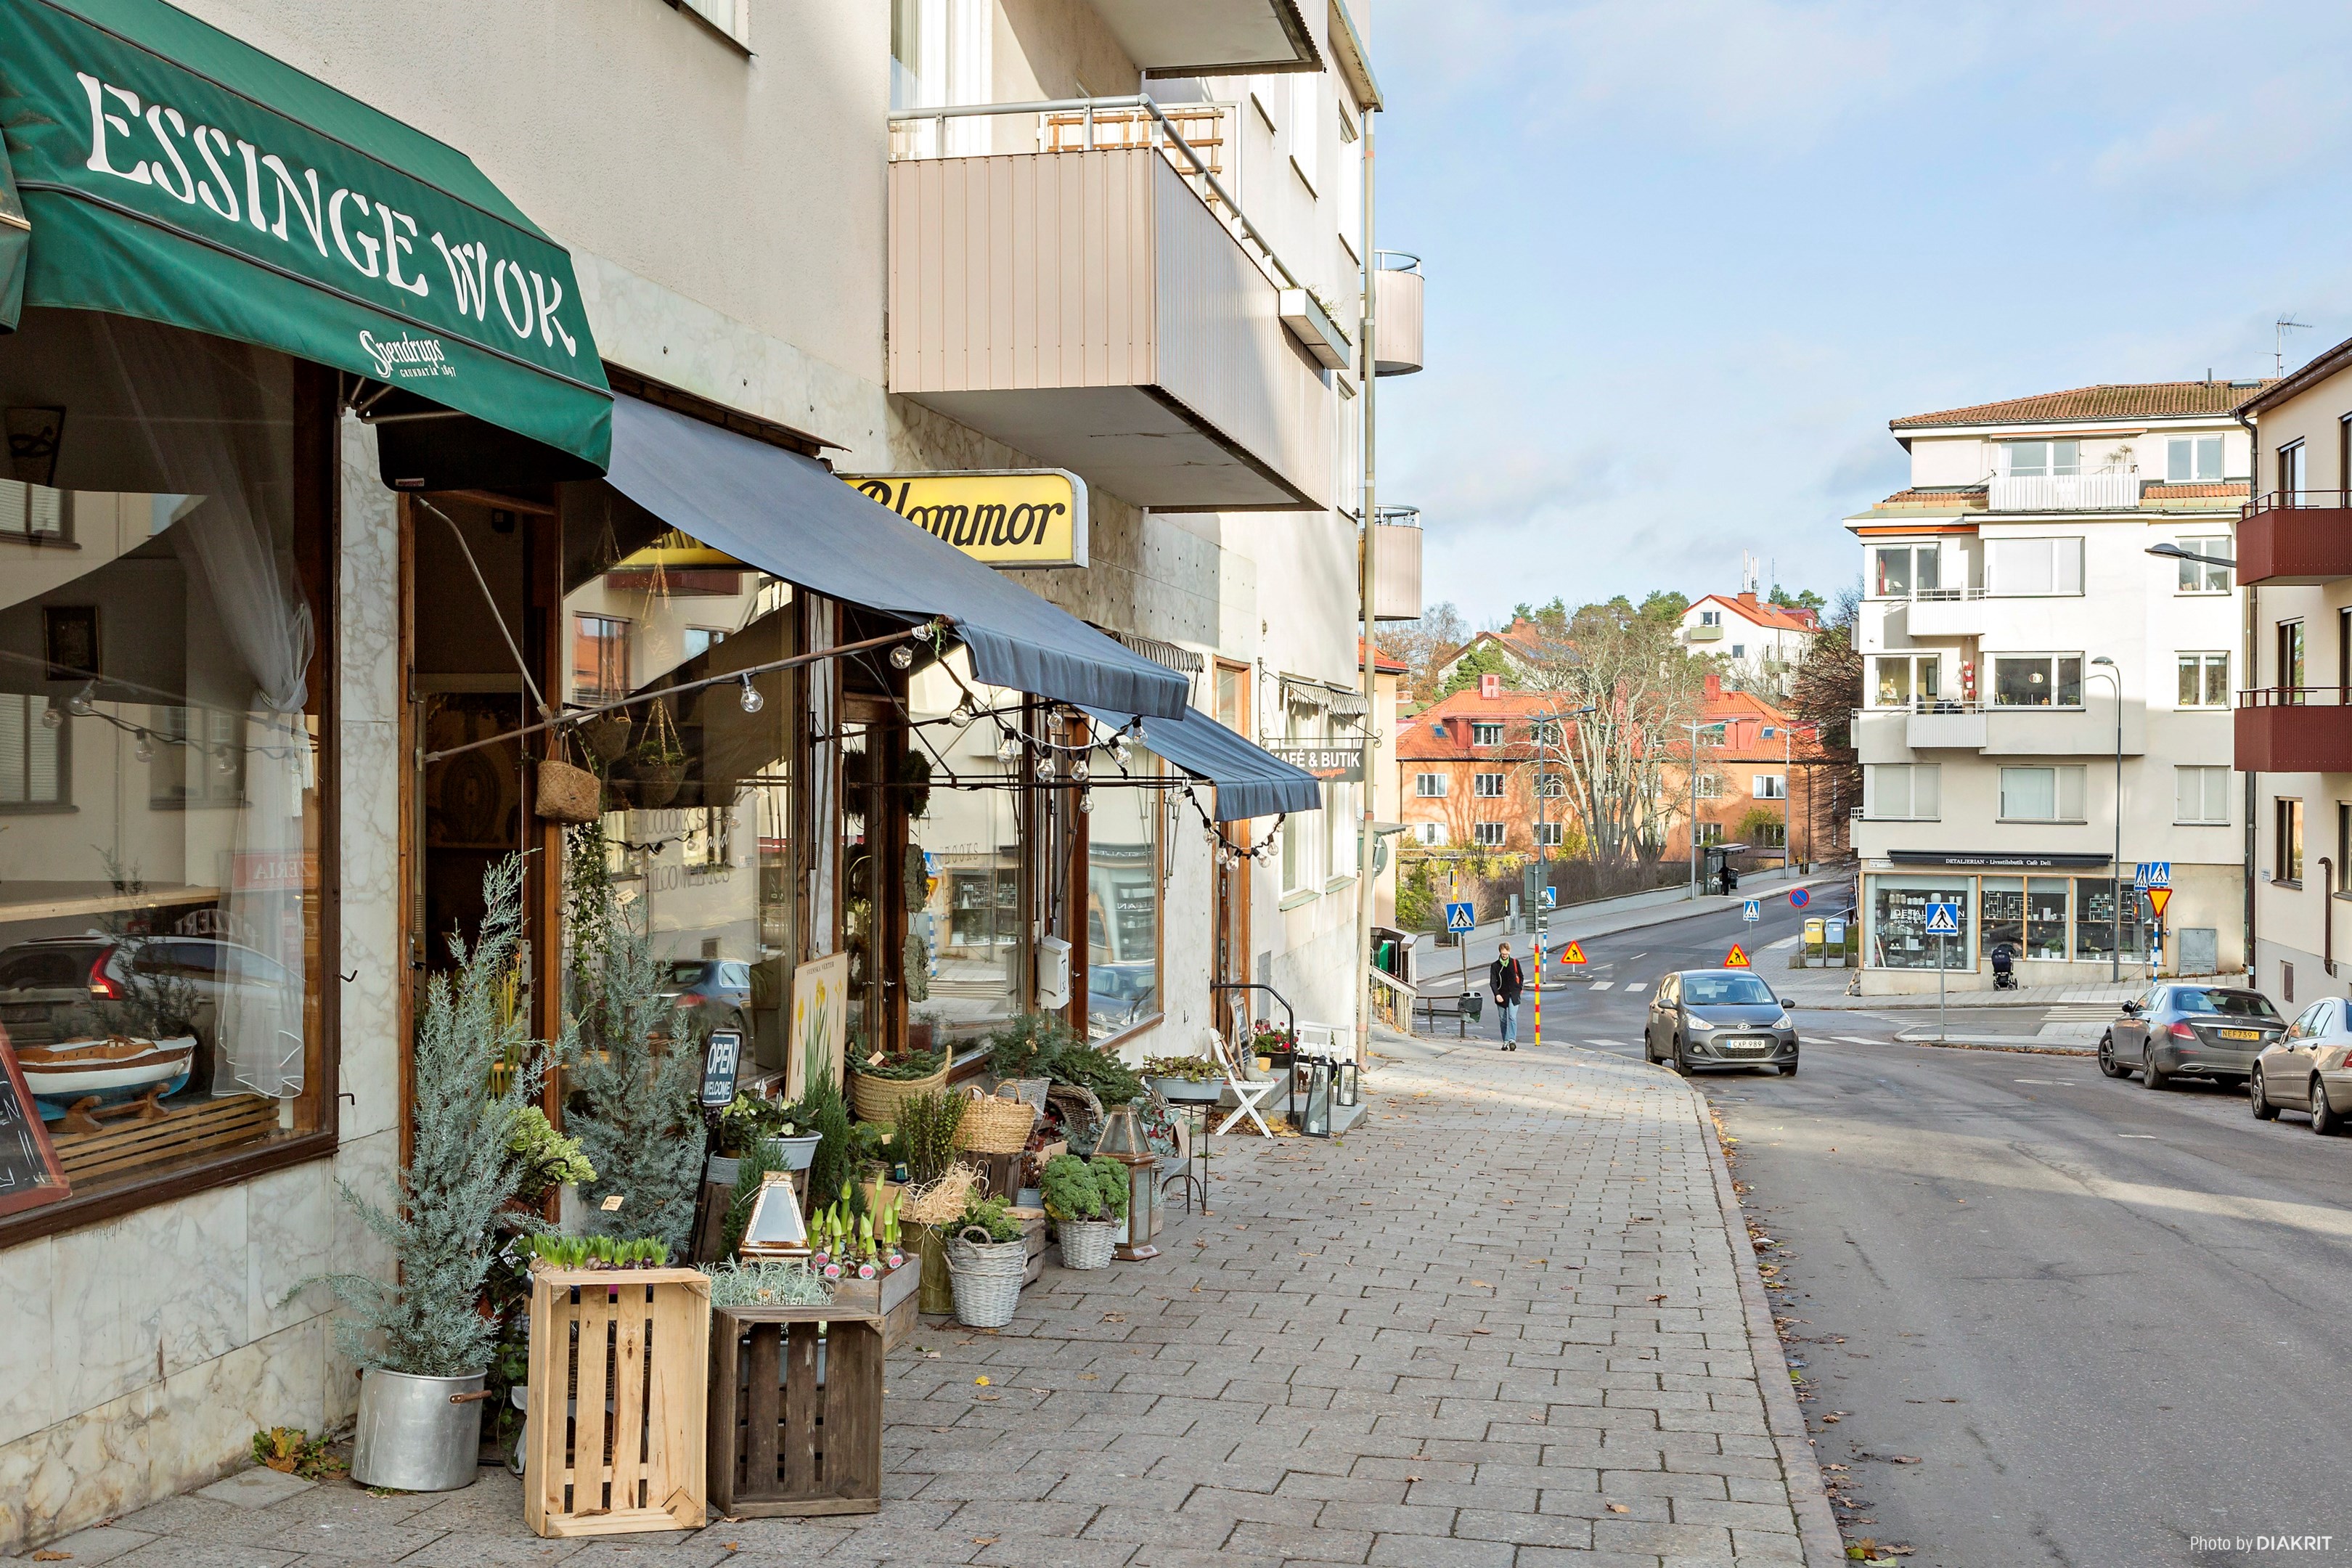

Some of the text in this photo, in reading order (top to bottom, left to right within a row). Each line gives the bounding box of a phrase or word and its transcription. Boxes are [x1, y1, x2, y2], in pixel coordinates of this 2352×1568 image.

[77, 72, 576, 357] ESSINGE WOK
[359, 330, 445, 378] Spendrups
[399, 368, 430, 378] GRUNDAT
[441, 364, 457, 377] 1897
[1308, 751, 1318, 768] &
[1321, 751, 1360, 768] BUTIK
[707, 1042, 736, 1074] OPEN
[703, 1080, 732, 1096] WELCOME
